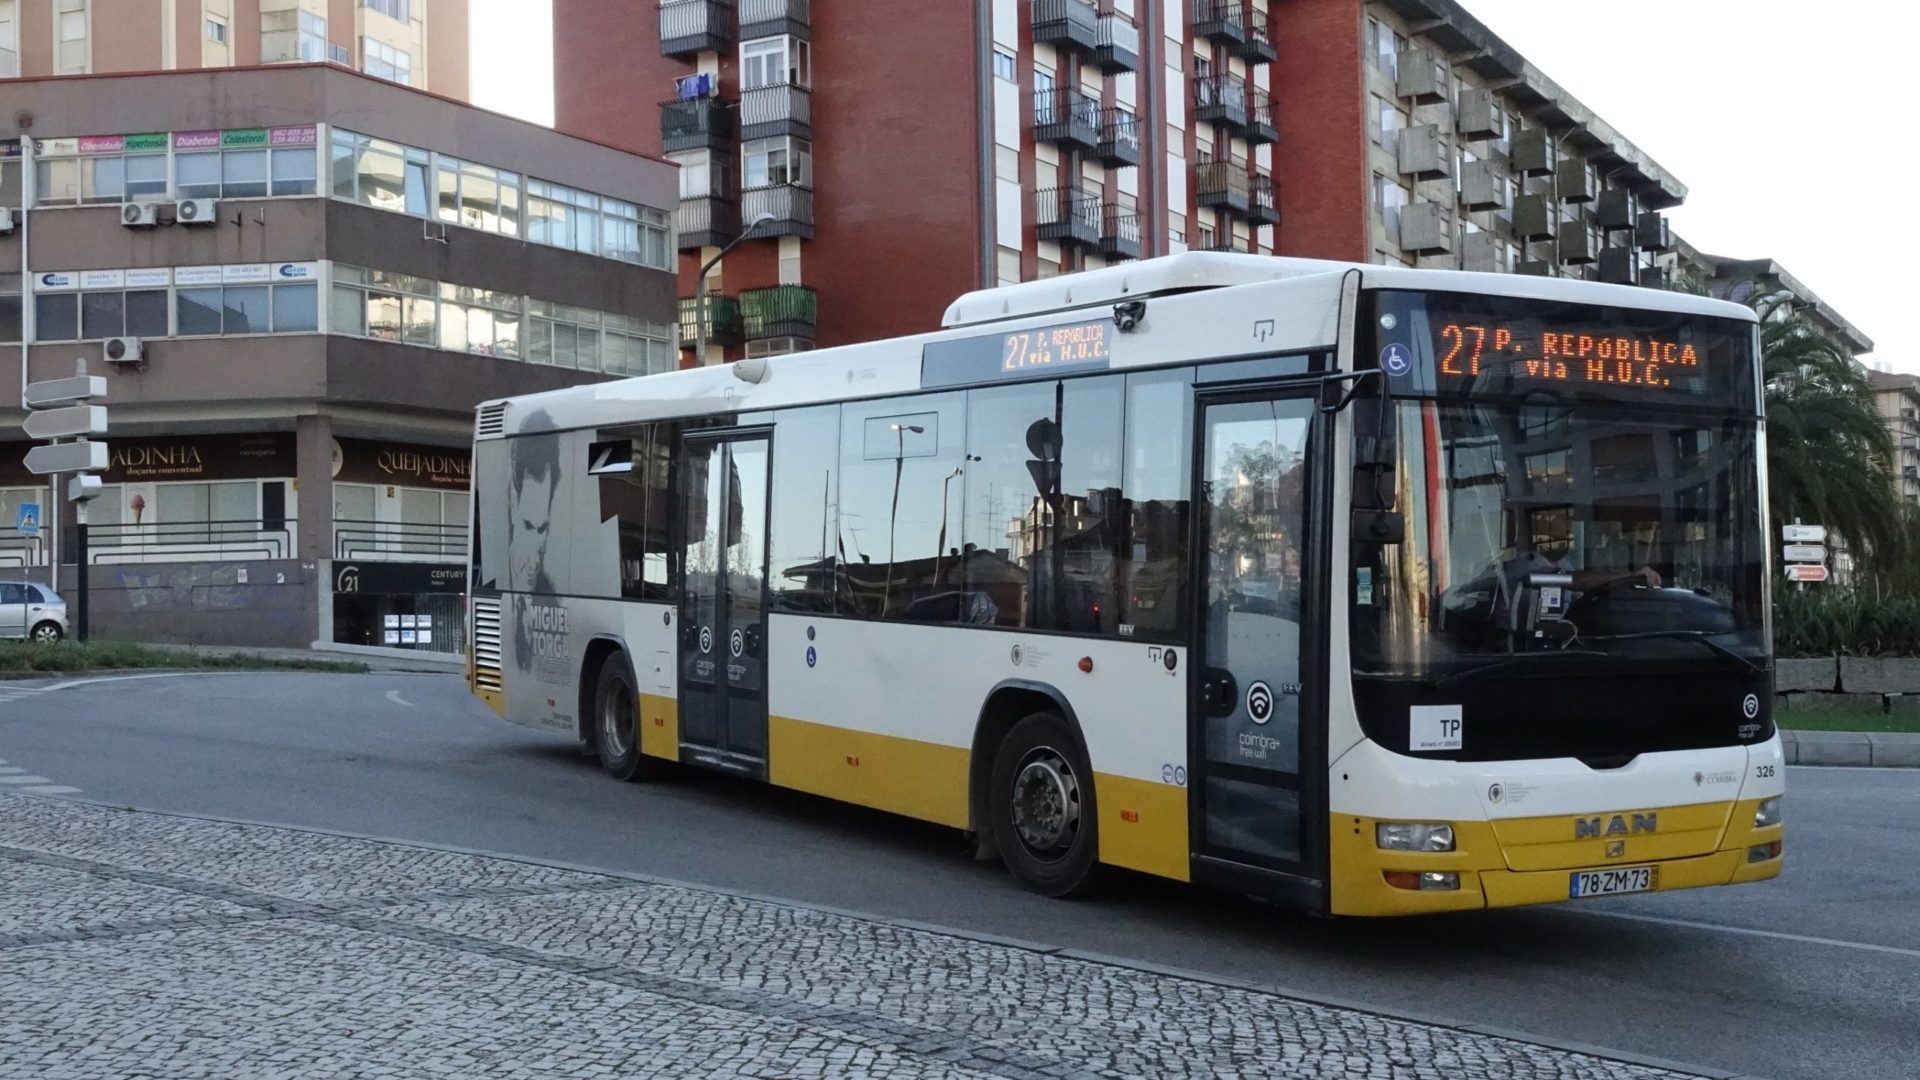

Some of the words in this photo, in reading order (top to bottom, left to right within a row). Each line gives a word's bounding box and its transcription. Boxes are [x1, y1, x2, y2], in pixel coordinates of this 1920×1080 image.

[176, 136, 218, 146] Diabetes
[224, 134, 265, 145] Colesterol
[1038, 331, 1048, 348] P.
[1442, 324, 1485, 375] 27
[1496, 328, 1521, 352] P.
[1006, 334, 1029, 369] 27
[1030, 347, 1051, 364] via
[1061, 341, 1109, 361] H.U.C.
[1526, 356, 1567, 378] via
[1587, 359, 1671, 386] H.U.C.
[126, 465, 157, 477] doçaria
[158, 464, 202, 475] conventual
[430, 570, 465, 579] CENTURY
[530, 605, 570, 635] MIGUEL
[532, 631, 570, 659] TORGA
[1440, 718, 1461, 738] TP
[1239, 731, 1281, 750] coimbra+
[1239, 745, 1254, 758] free
[1756, 765, 1775, 778] 326
[1576, 812, 1657, 839] MAN
